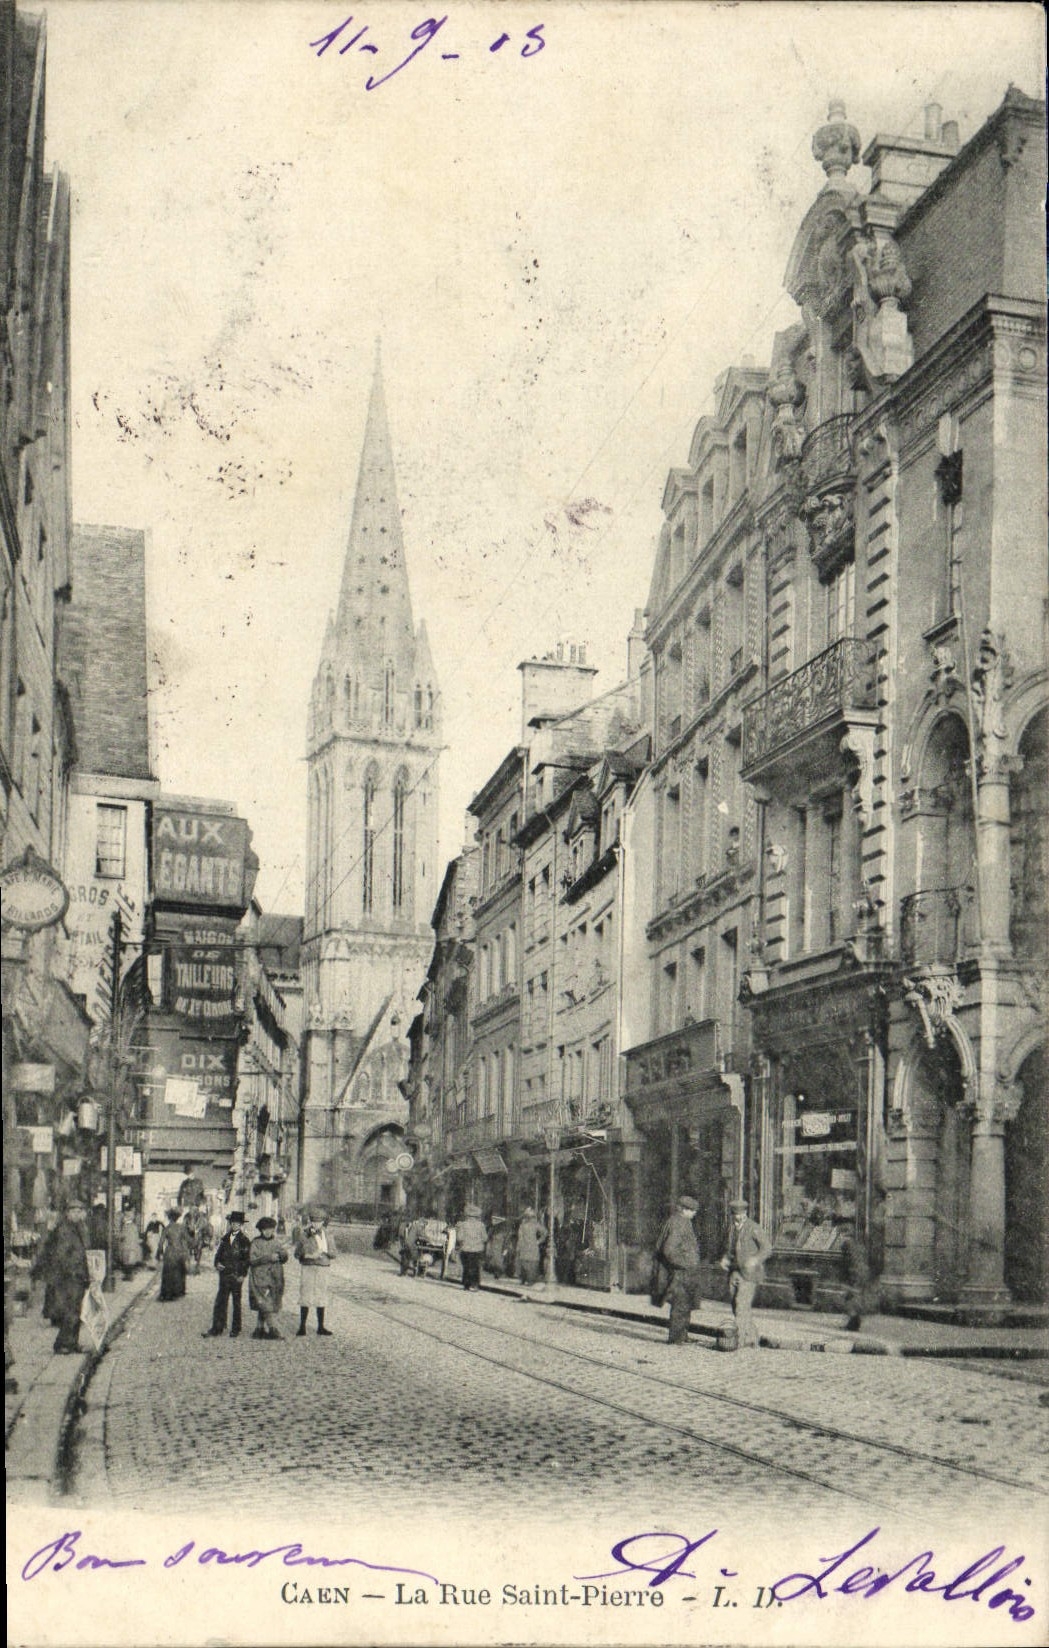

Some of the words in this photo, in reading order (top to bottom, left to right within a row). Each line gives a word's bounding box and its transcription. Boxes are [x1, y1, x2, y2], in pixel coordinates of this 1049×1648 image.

[157, 816, 224, 845] AUX
[68, 885, 110, 907] GROS
[175, 963, 234, 991] TAILLEURS
[181, 1053, 227, 1071] DIX
